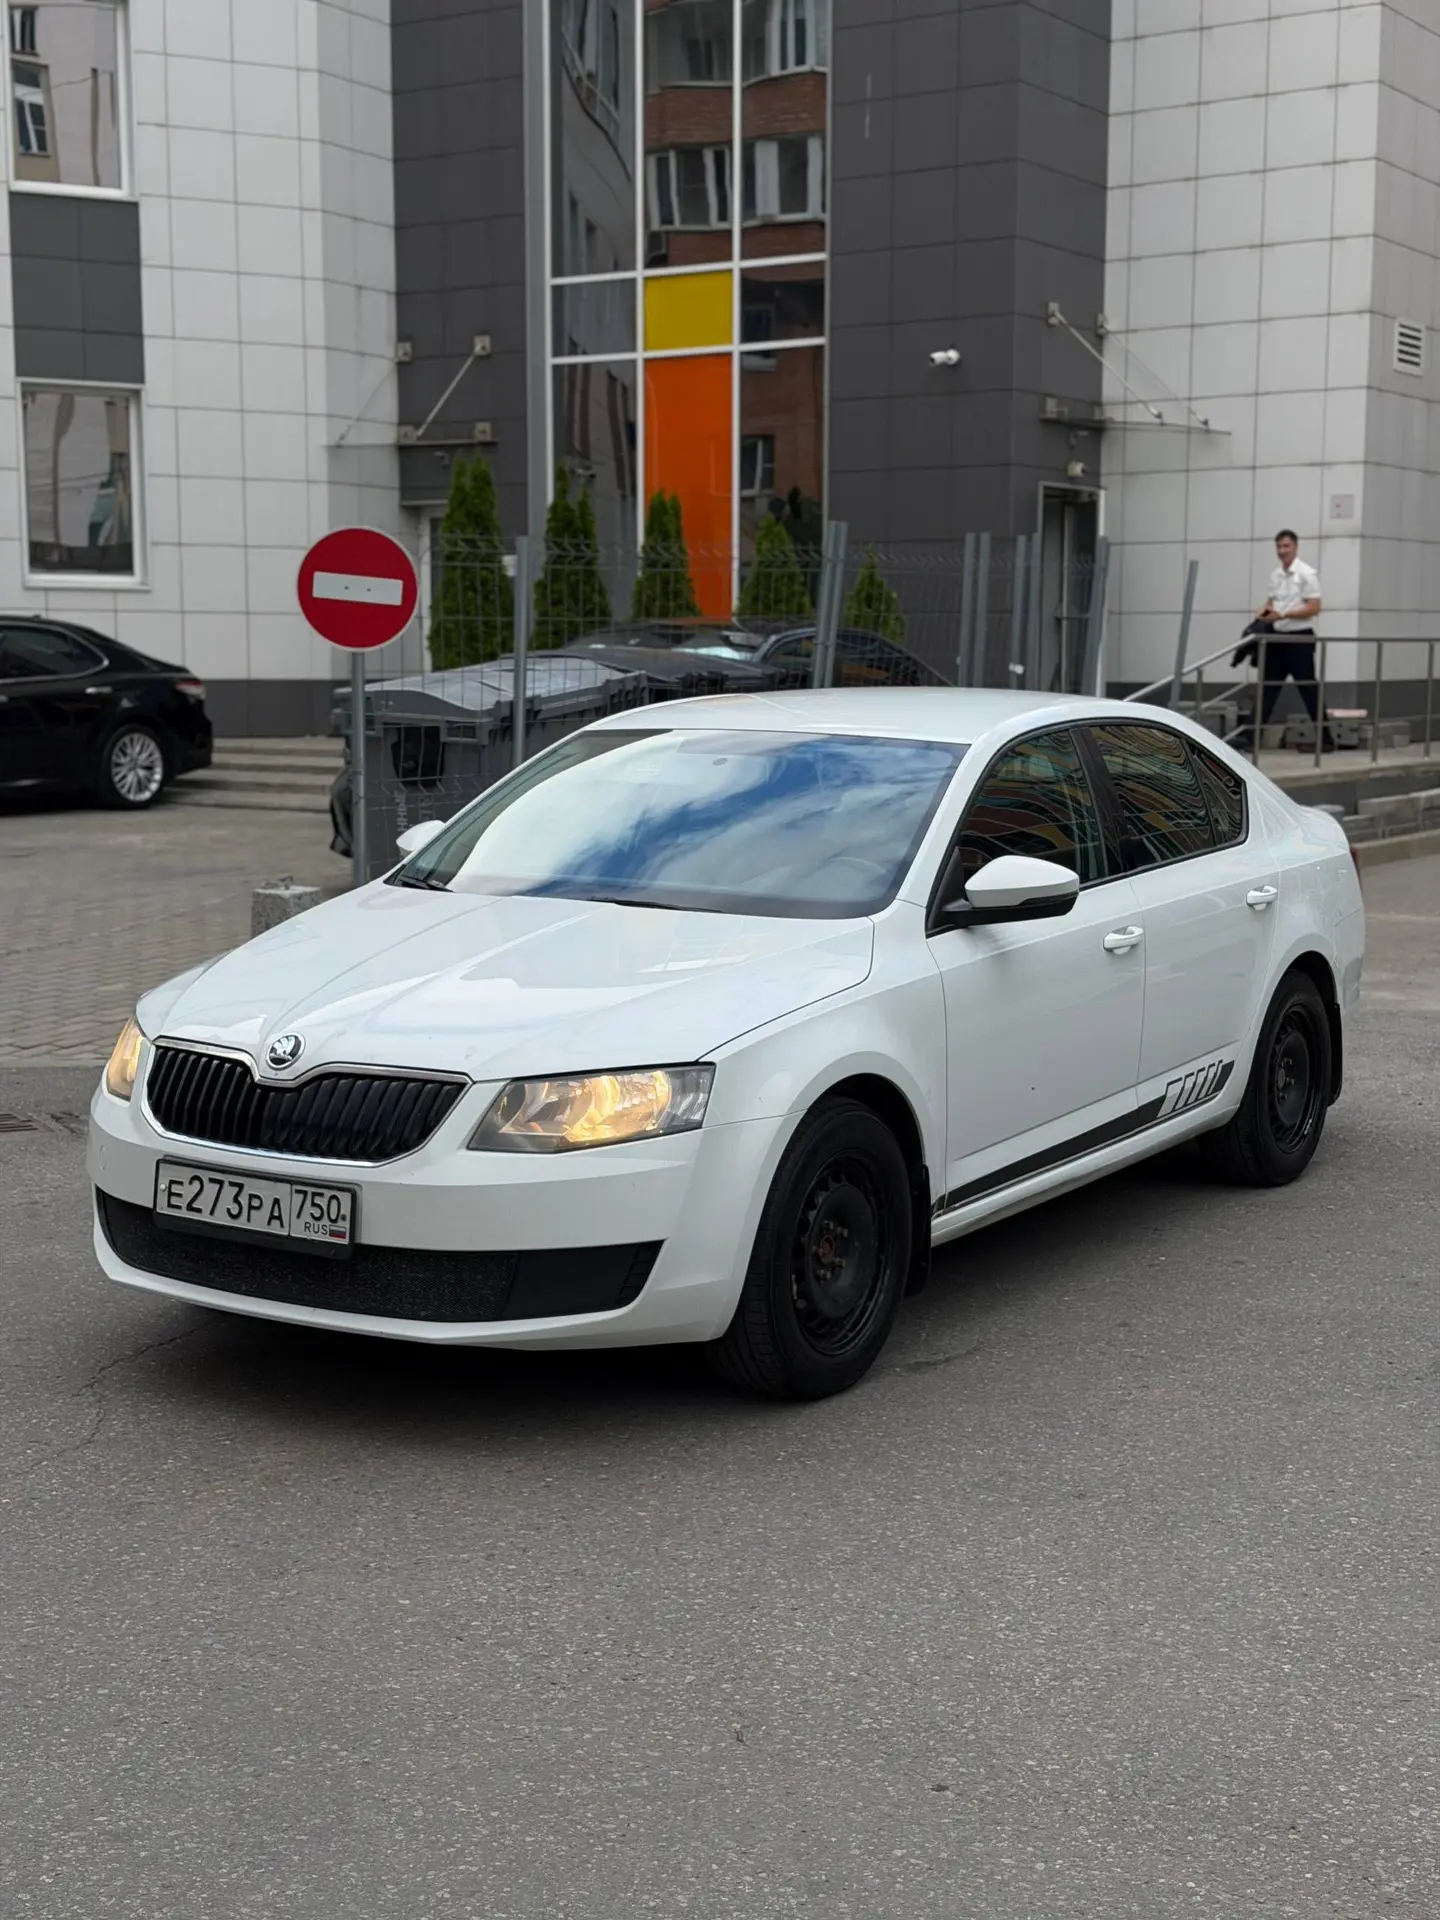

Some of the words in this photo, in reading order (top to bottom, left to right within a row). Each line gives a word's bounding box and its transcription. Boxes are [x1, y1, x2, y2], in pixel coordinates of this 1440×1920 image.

[394, 789, 408, 832] ННЫЕ
[294, 1189, 341, 1224] 750
[304, 1221, 328, 1236] RUS
